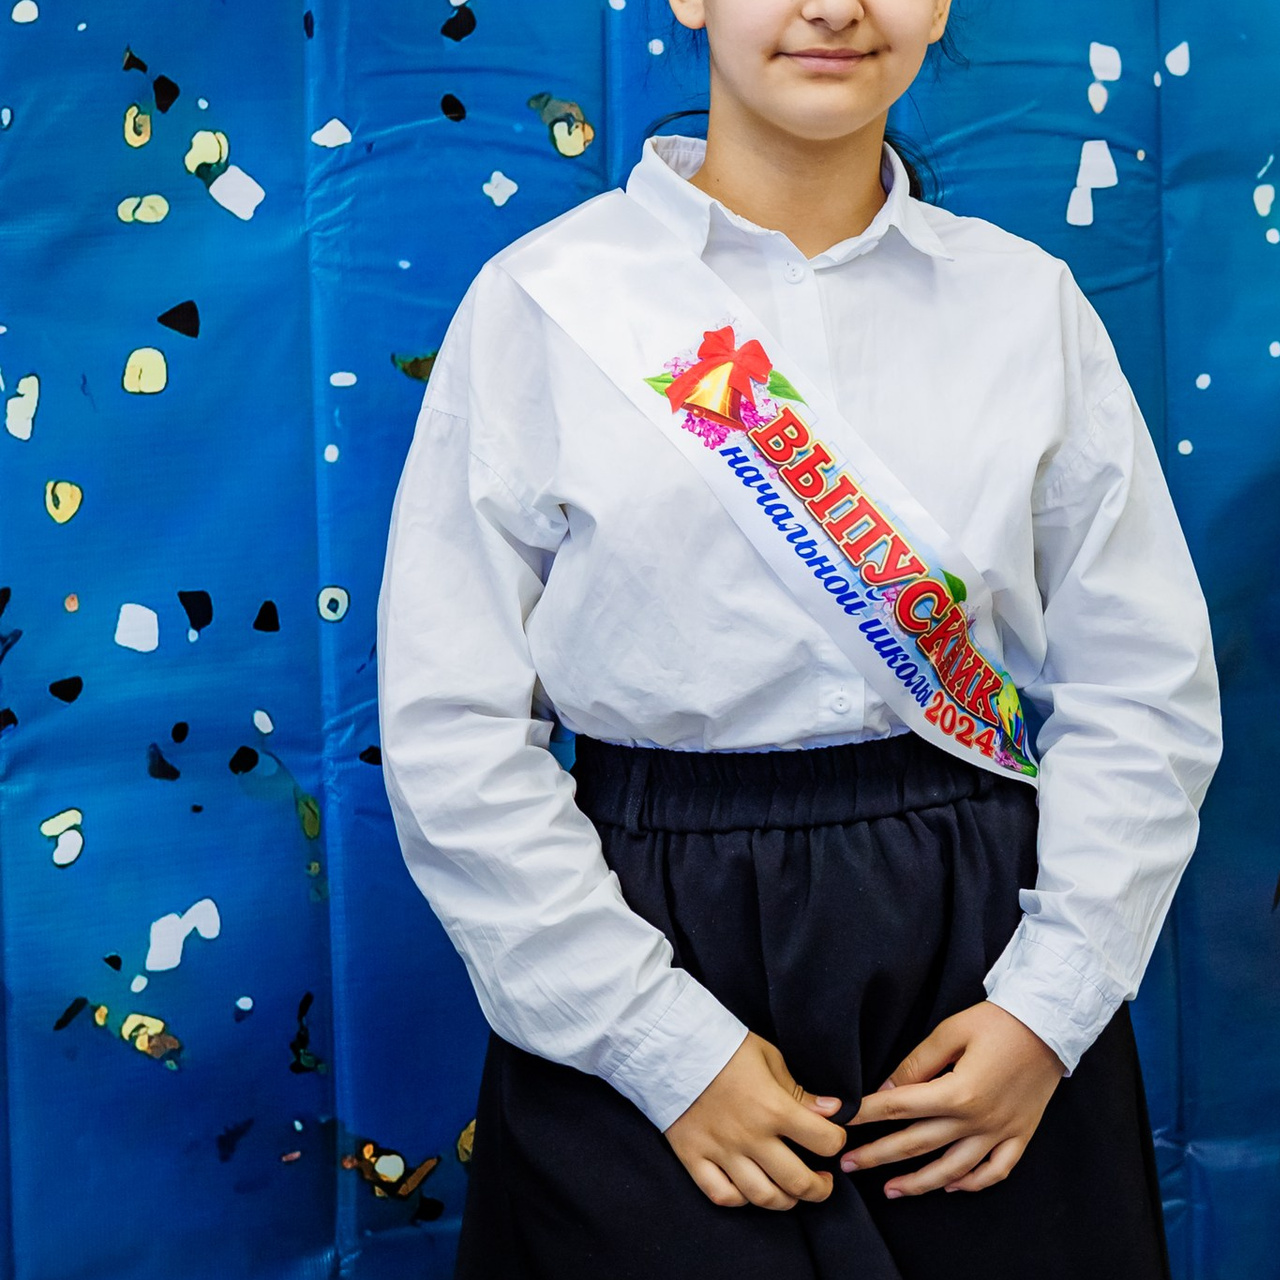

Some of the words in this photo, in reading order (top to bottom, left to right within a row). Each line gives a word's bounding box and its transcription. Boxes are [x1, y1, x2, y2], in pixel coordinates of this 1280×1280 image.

[719, 446, 885, 616] начальной
[858, 618, 934, 708] школы
[923, 691, 997, 759] 2024
